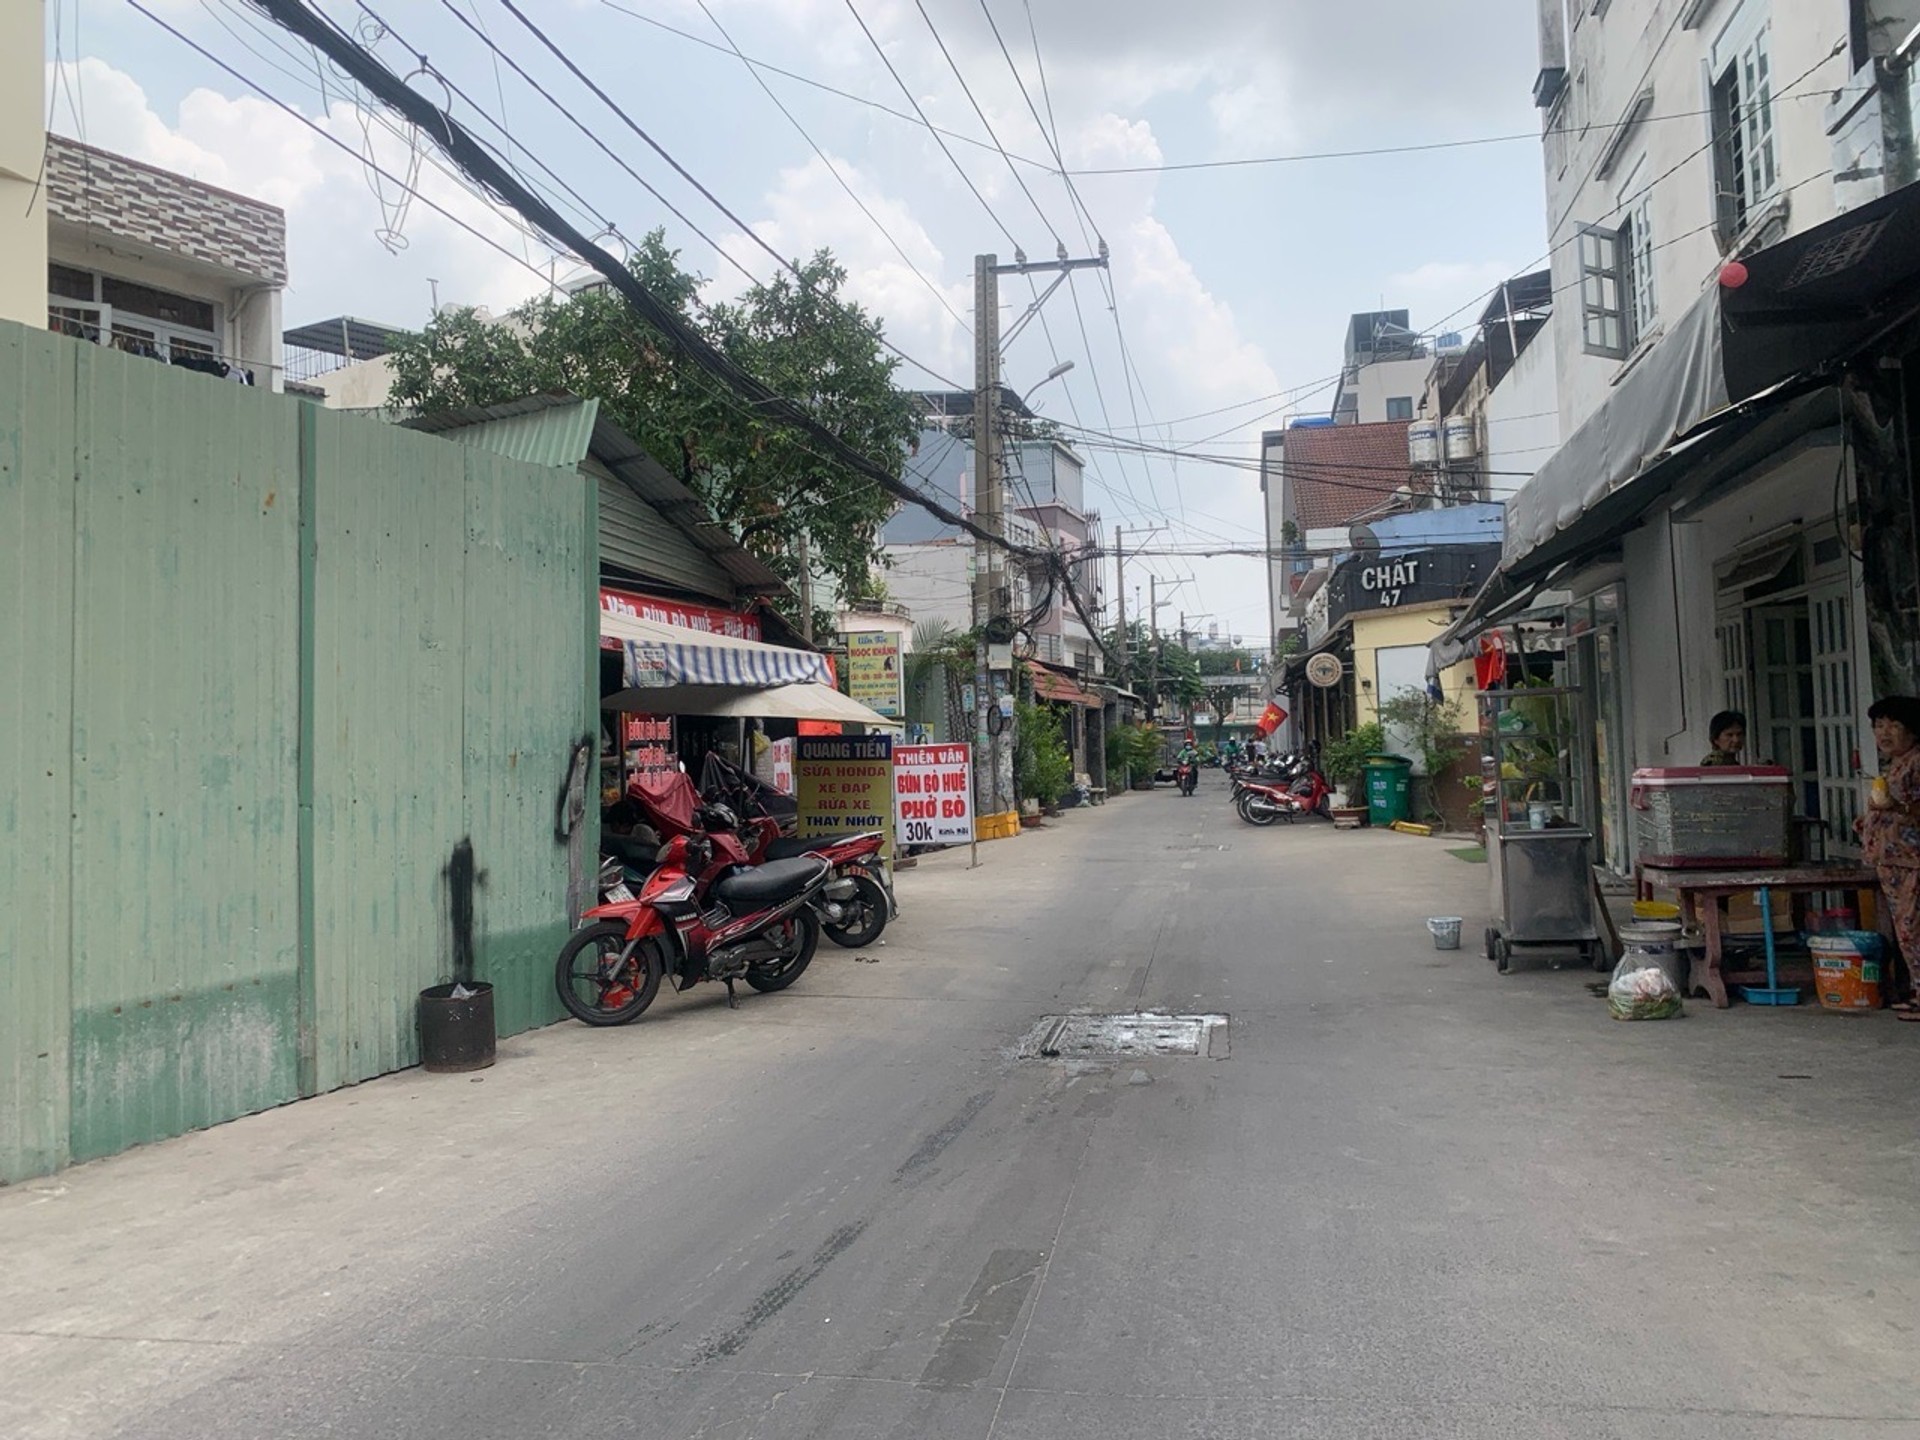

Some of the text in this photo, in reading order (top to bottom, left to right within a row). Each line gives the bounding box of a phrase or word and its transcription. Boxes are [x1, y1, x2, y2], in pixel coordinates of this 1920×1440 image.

[1361, 554, 1418, 590] CHẤT
[1380, 590, 1400, 606] 47
[803, 742, 850, 758] QUANG
[854, 738, 886, 758] TIẾN
[897, 748, 964, 764] THIÊN VÂN
[803, 764, 886, 776] SỬA HONDA
[897, 764, 966, 793] BÚN BÒ HUẾ
[818, 783, 871, 795] XE ĐẠP
[817, 797, 871, 810] RỬA XE
[901, 794, 965, 819] PHỞ BÒ
[805, 814, 884, 826] THAY NHỚT
[906, 822, 933, 840] 30k
